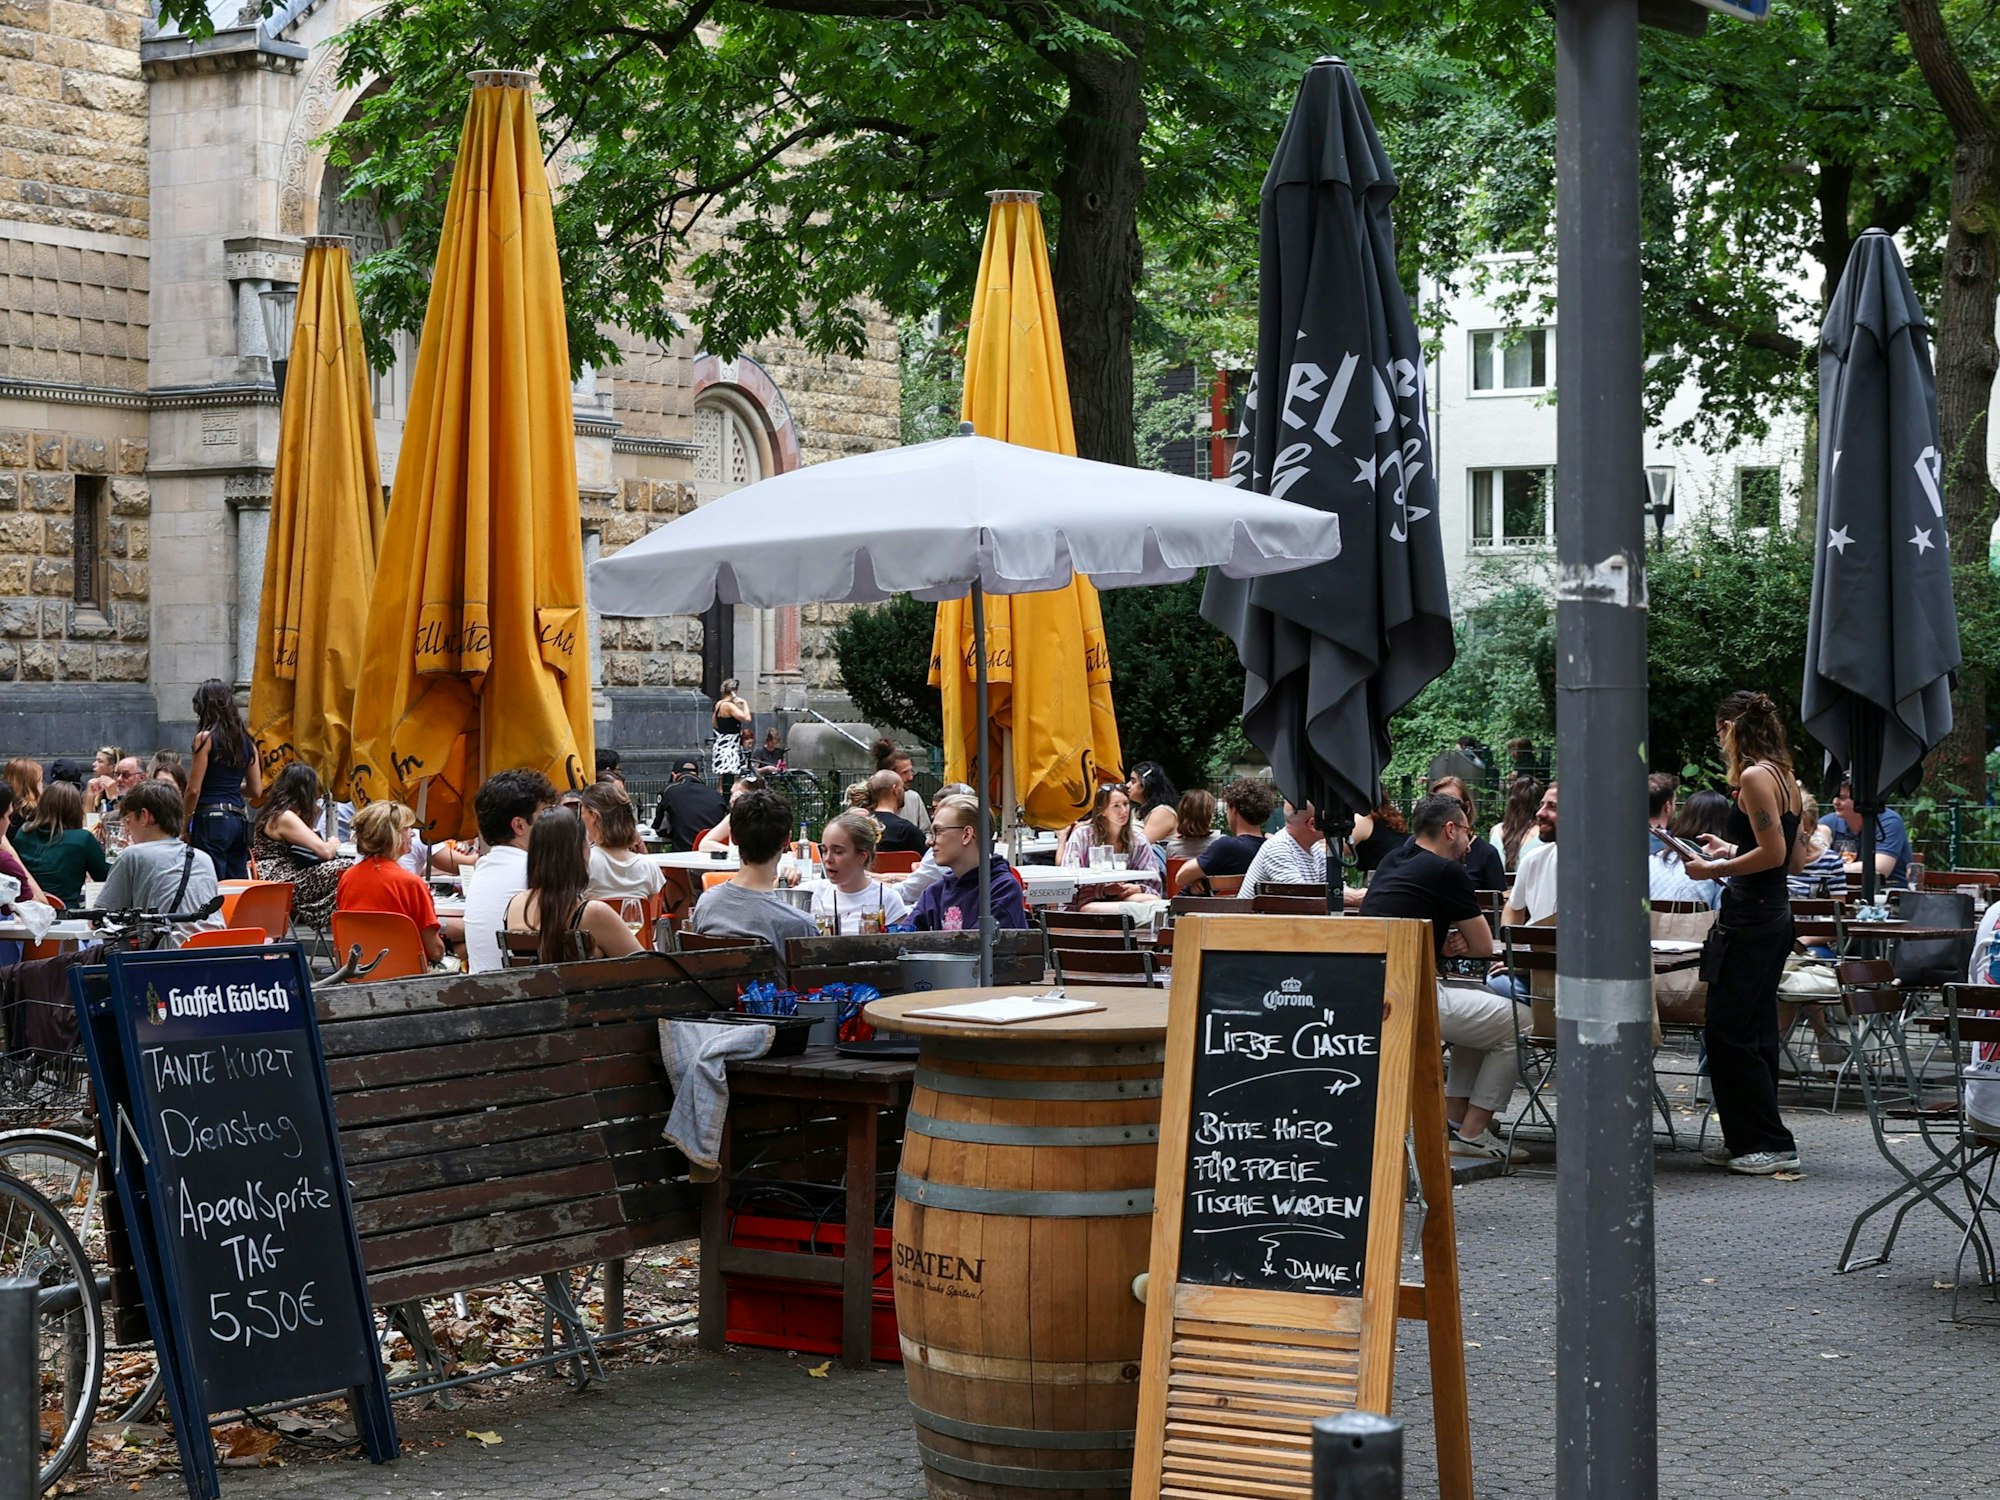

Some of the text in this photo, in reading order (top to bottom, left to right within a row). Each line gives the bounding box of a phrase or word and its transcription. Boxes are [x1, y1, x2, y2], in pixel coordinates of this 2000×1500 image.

[1029, 887, 1072, 898] RESERVIERT
[168, 981, 290, 1018] Gaffel Kölsch
[1263, 990, 1316, 1011] Corona
[142, 1045, 293, 1093] TANTE KURT
[160, 1108, 303, 1159] Dienstag
[1193, 1150, 1240, 1183] FÜR
[1191, 1189, 1363, 1219] TISCHE WARTEN
[220, 1233, 285, 1282] TAG
[897, 1242, 986, 1284] SPATEN
[210, 1281, 323, 1347] 5,50€
